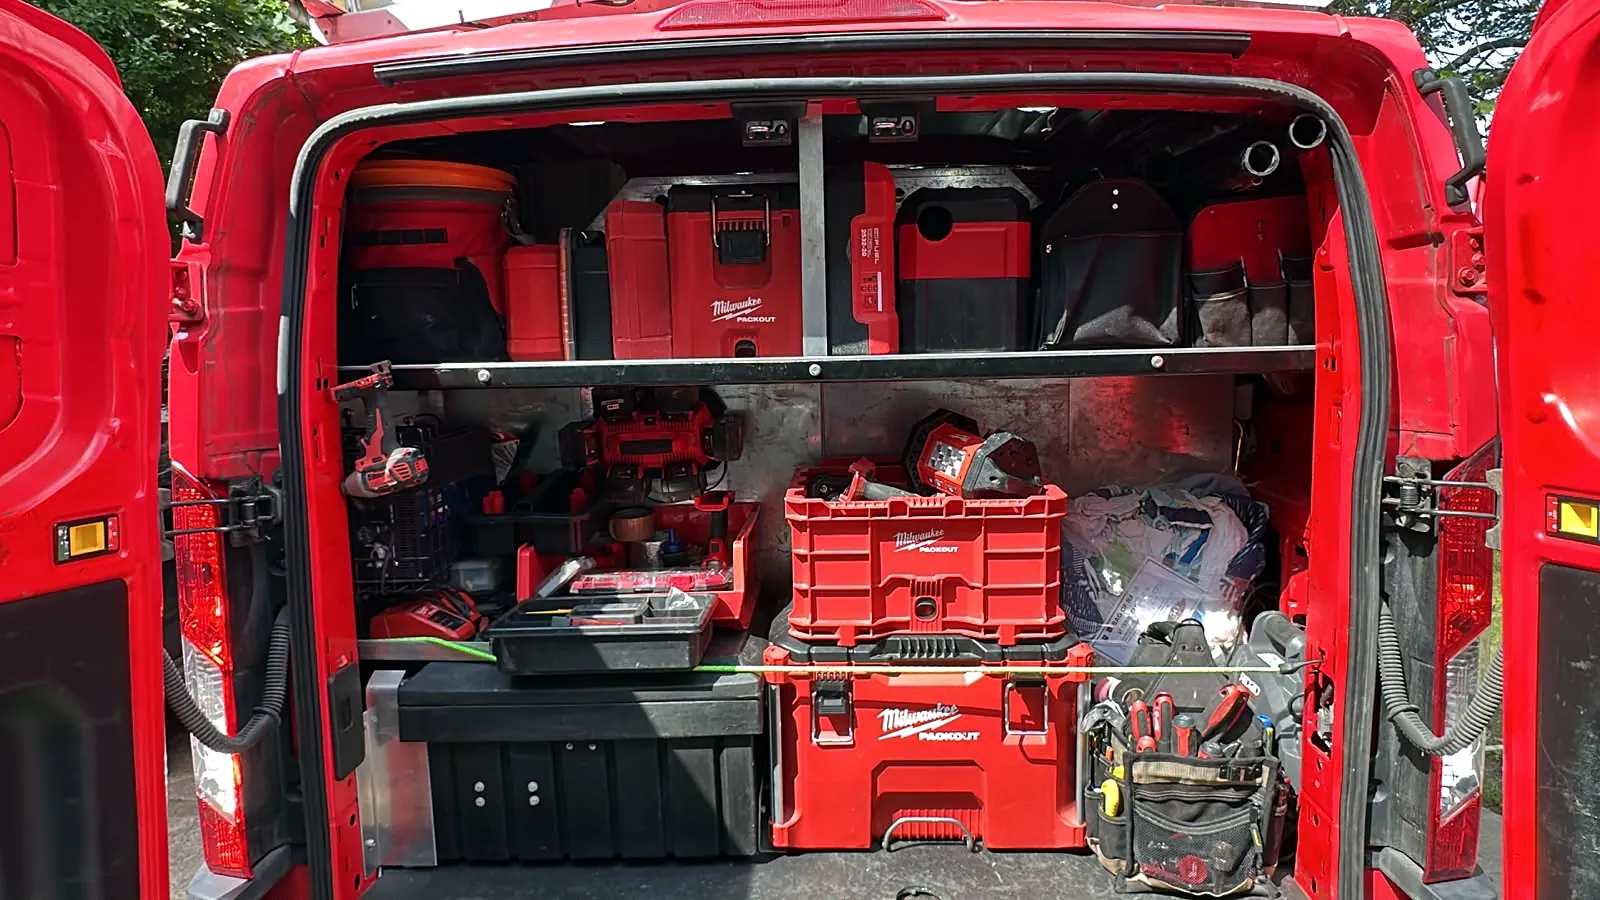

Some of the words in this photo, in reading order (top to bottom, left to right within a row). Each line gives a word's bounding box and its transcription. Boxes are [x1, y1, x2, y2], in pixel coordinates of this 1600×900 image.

[710, 296, 762, 317] Milwaukee
[893, 528, 945, 547] Milwaukee
[877, 702, 959, 732] Milwaukee
[918, 731, 980, 741] PACKOUT
